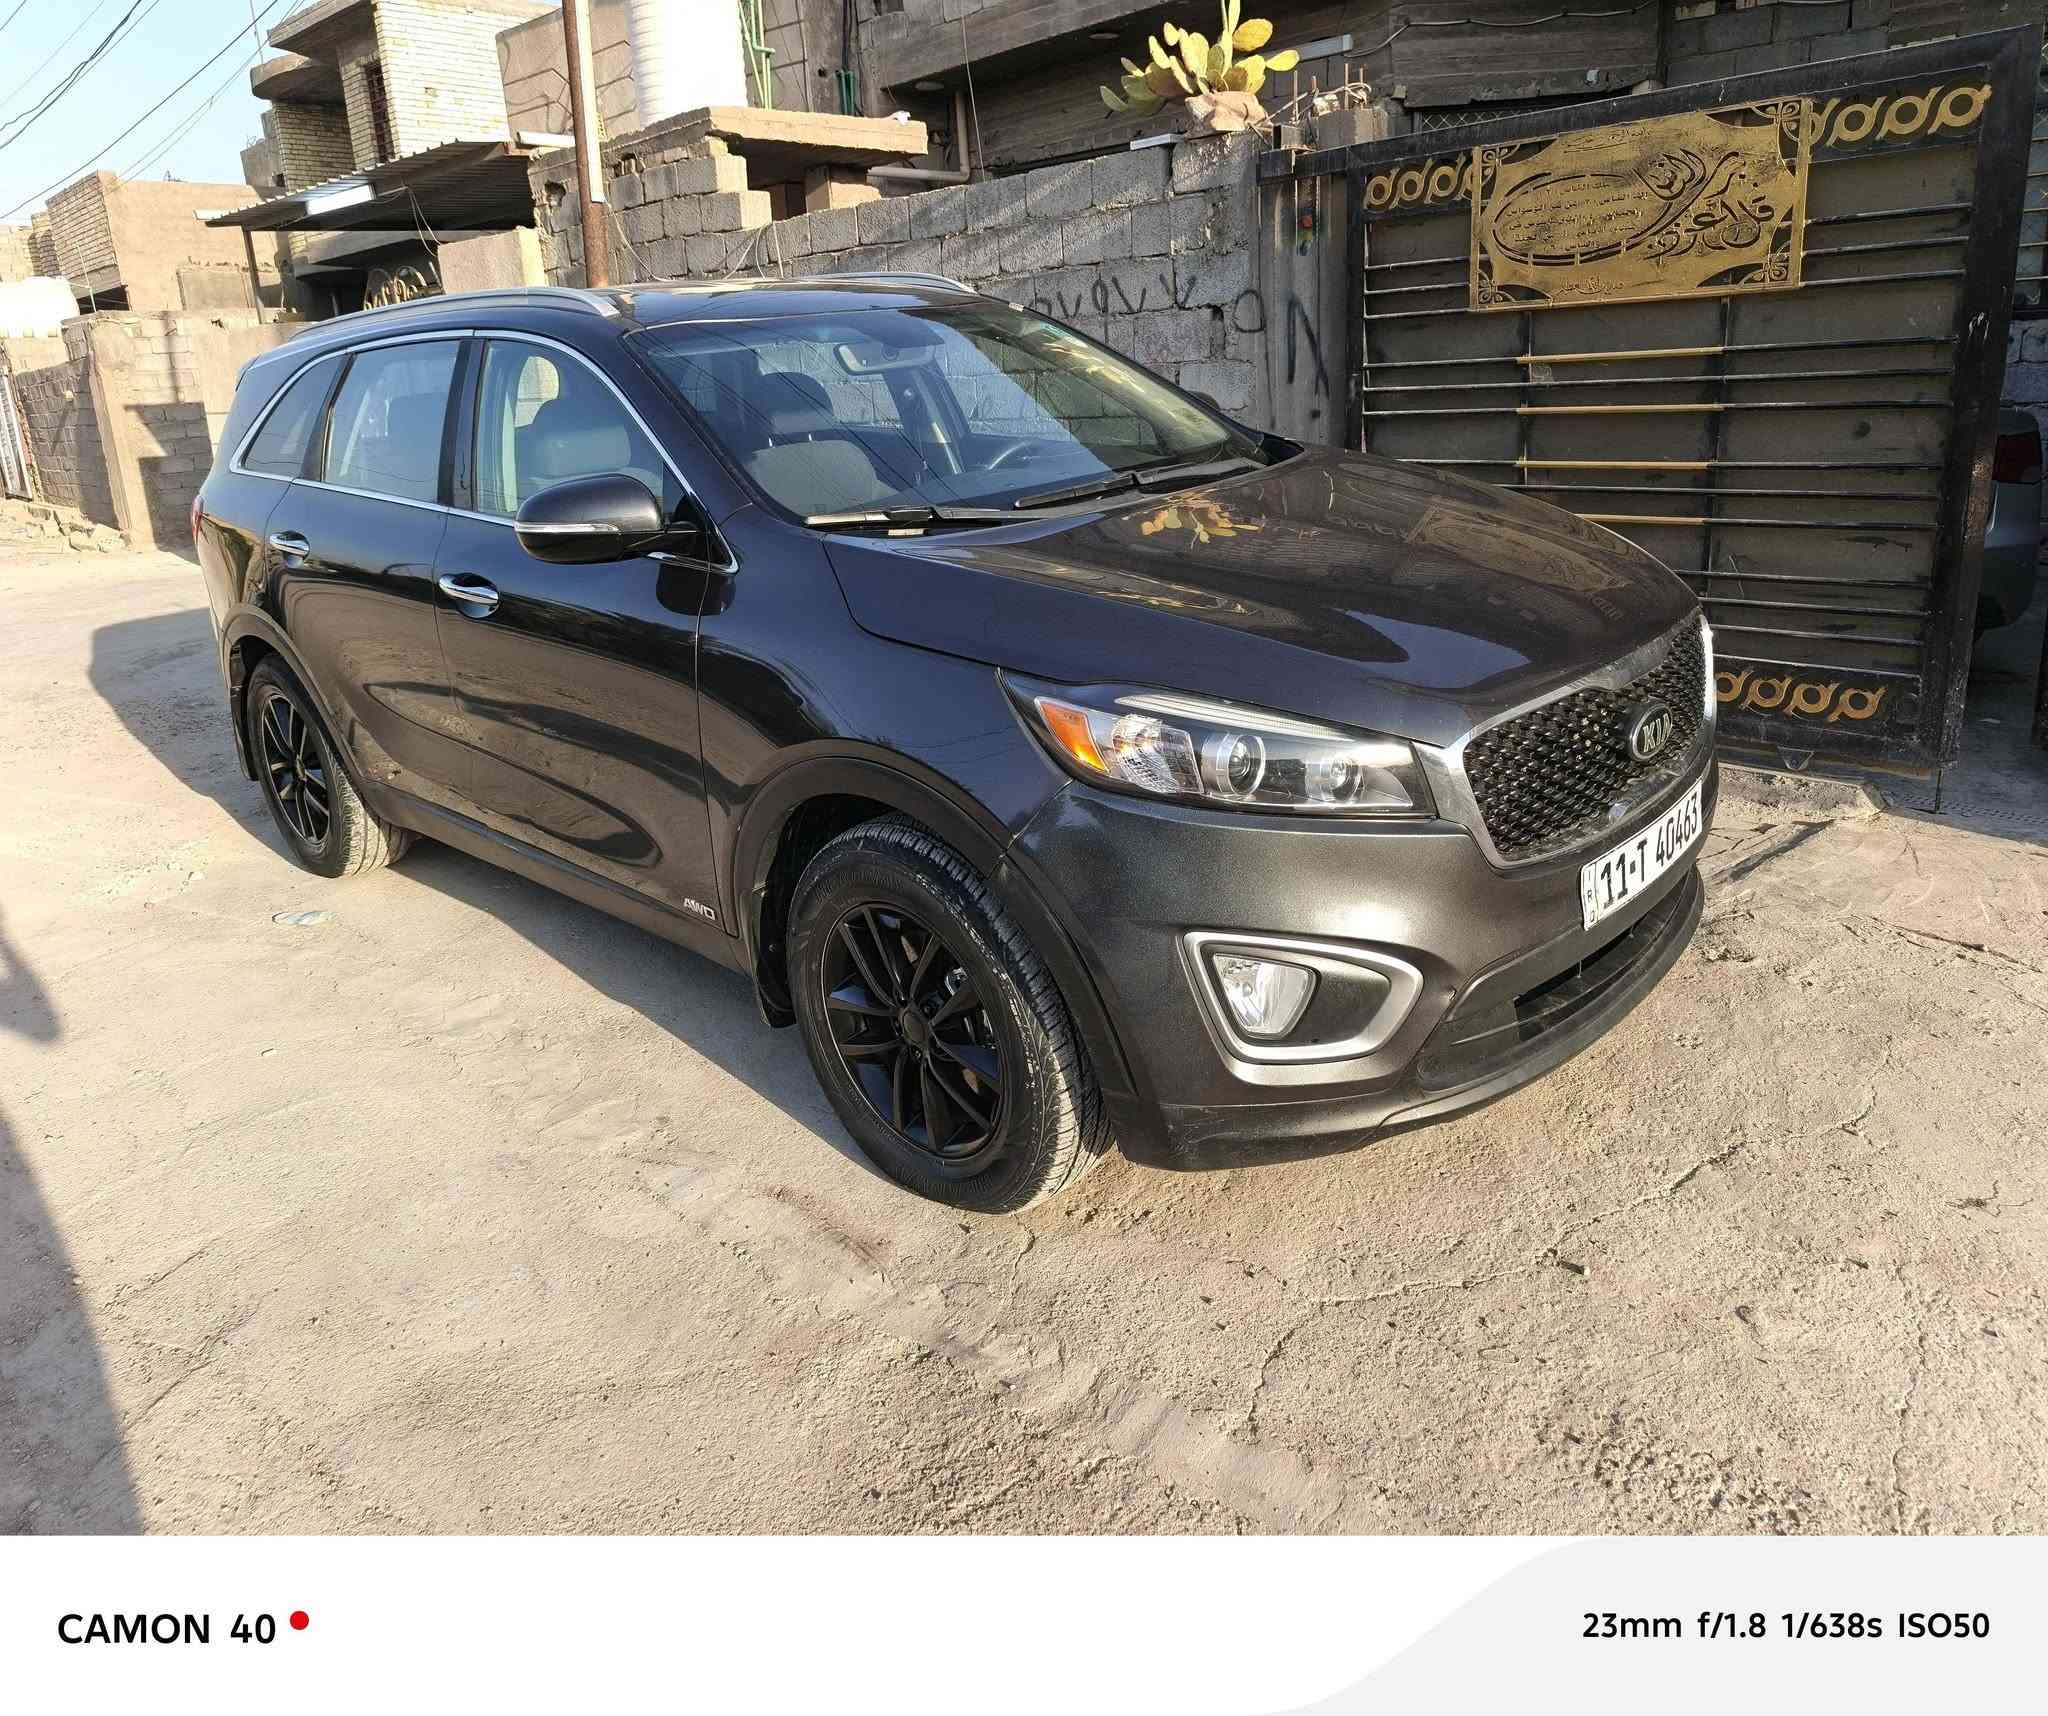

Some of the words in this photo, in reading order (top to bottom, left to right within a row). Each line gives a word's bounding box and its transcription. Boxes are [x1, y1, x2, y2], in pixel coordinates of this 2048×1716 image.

[1641, 711, 1673, 753] KIA
[1655, 795, 1699, 867] 40463
[683, 897, 717, 921] AWD
